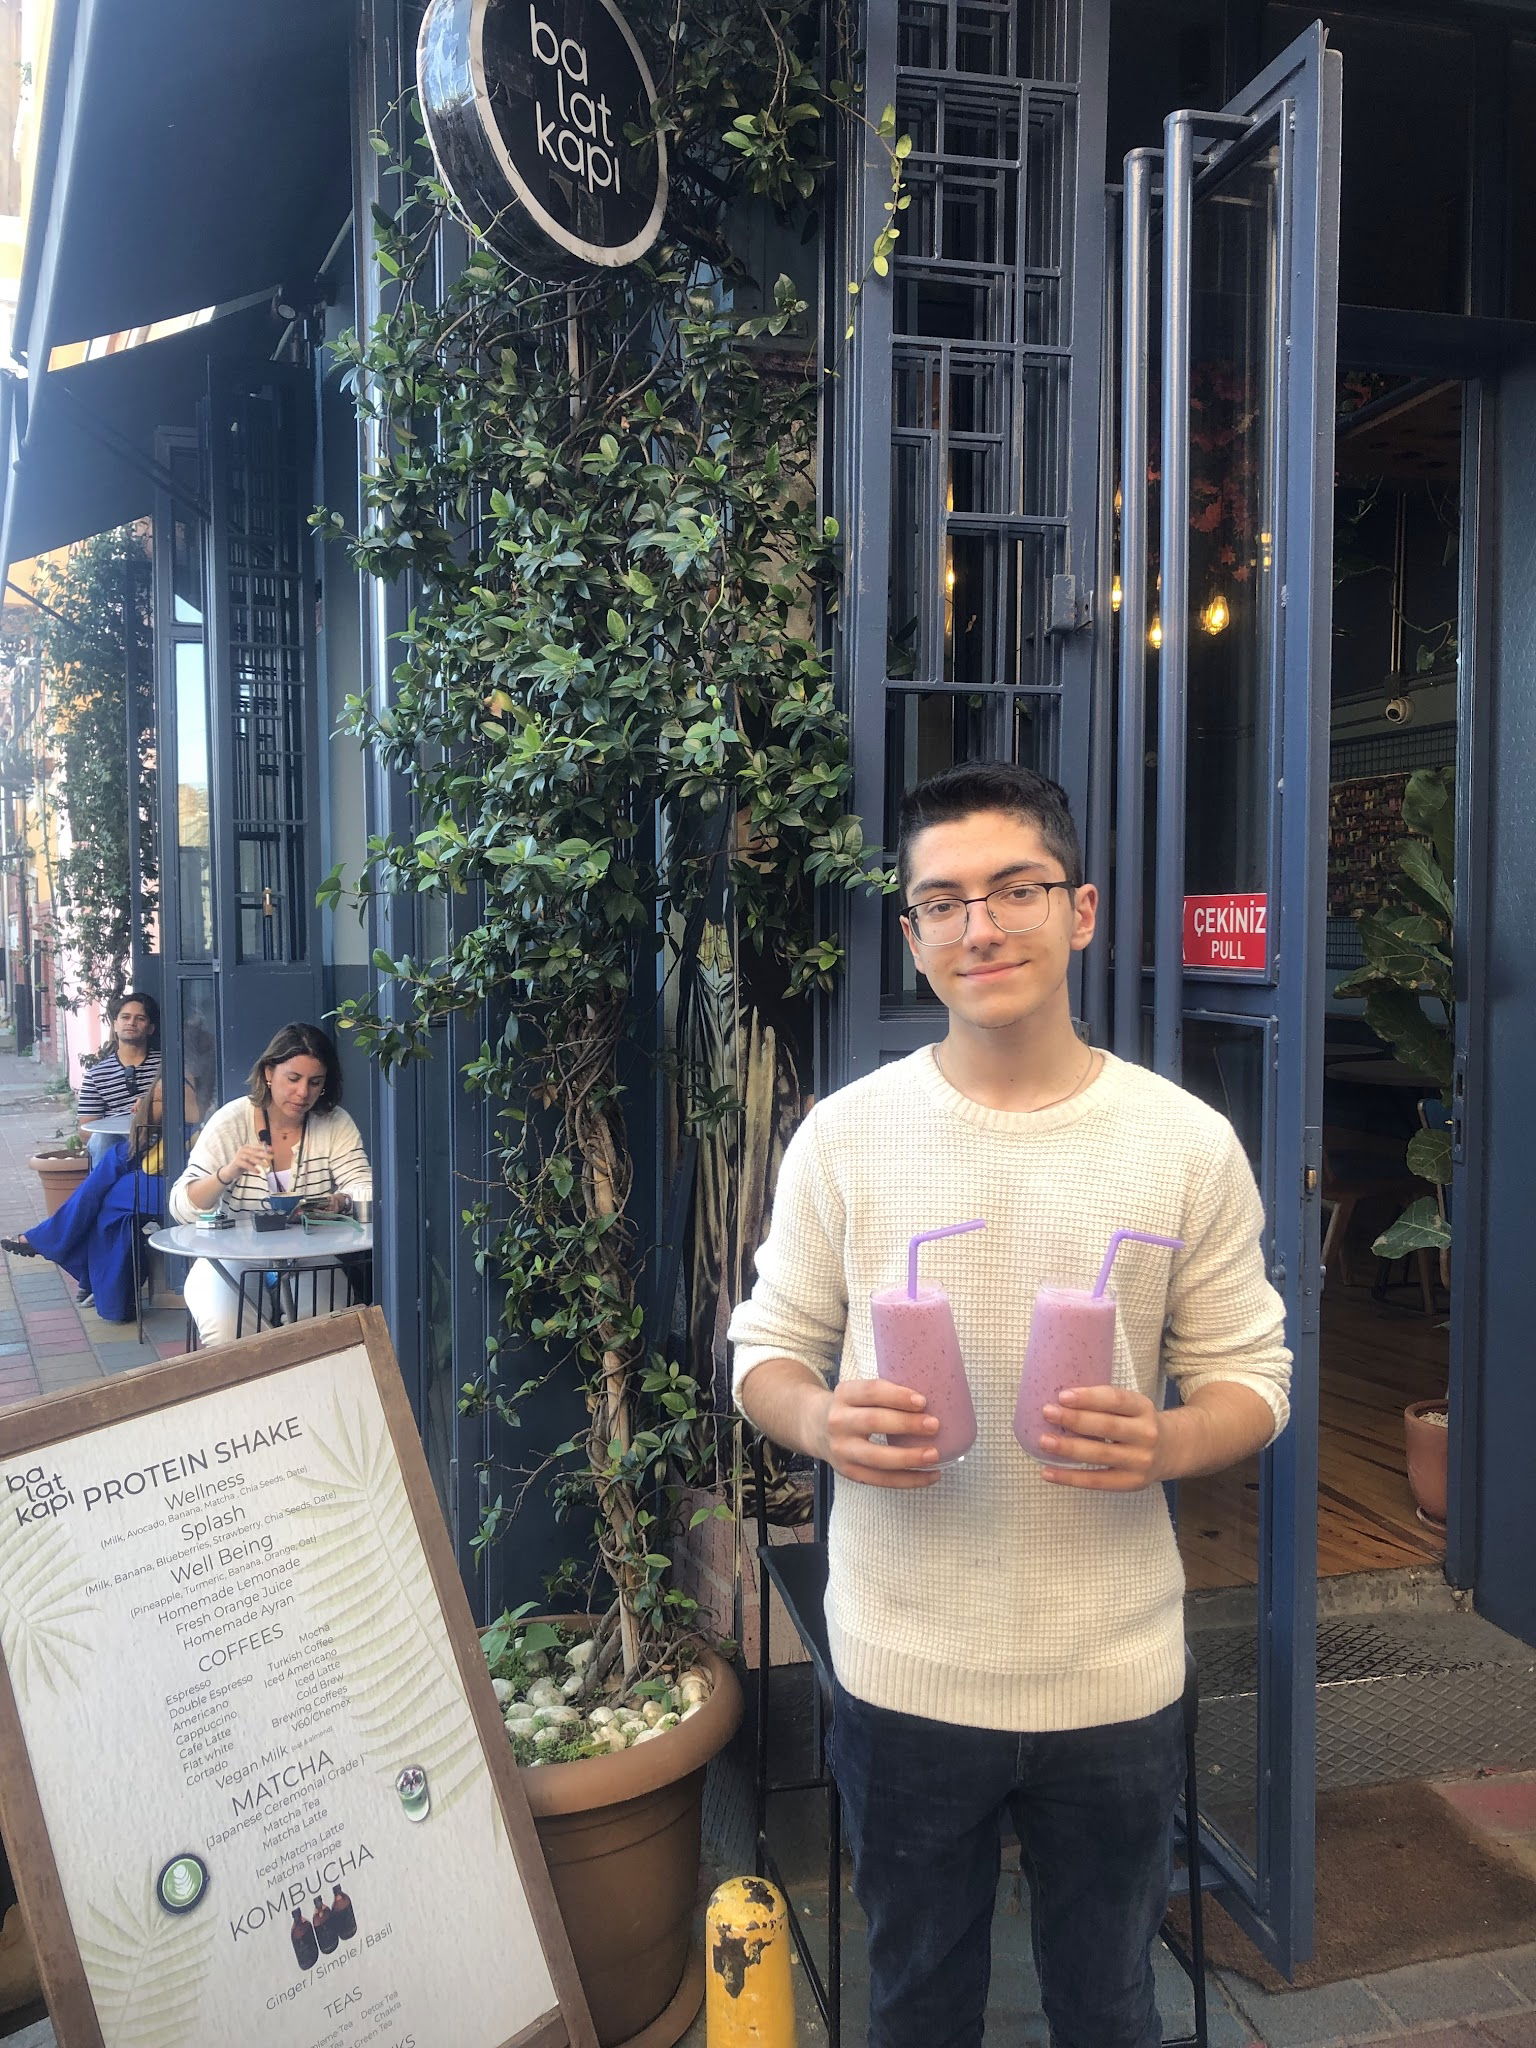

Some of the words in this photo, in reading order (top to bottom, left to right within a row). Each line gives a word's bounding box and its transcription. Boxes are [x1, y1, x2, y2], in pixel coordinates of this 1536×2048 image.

[530, 4, 588, 86] ba
[557, 69, 614, 147] lat
[536, 101, 621, 194] kapı
[1194, 900, 1266, 937] ÇEKİNİZ
[1211, 940, 1246, 960] PULL
[6, 1466, 45, 1493] ba
[83, 1449, 208, 1511] PROTEIN
[214, 1416, 303, 1463] SHAKE
[26, 1473, 66, 1502] lat
[101, 1534, 126, 1549] (Milk,
[127, 1519, 166, 1539] Avocado,
[168, 1505, 202, 1522] Banana,
[240, 1484, 258, 1496] Chia
[260, 1474, 286, 1489] Seeds,
[286, 1464, 308, 1479] Date)
[164, 1473, 245, 1510] Wellness
[85, 1580, 112, 1597] (Milk,
[114, 1564, 155, 1584] Banana,
[156, 1541, 212, 1567] Blueberries,
[212, 1520, 263, 1544] Strawberry,
[264, 1511, 284, 1524] Chia
[285, 1501, 312, 1516] Seeds,
[313, 1490, 337, 1504] Date)
[181, 1505, 245, 1541] Splash
[130, 1590, 183, 1619] (Pineapple,
[184, 1573, 228, 1595] Turmeric,
[228, 1558, 264, 1577] Banana,
[264, 1544, 298, 1562] Orange,
[298, 1535, 317, 1548] Oat)
[170, 1554, 214, 1584] Well
[218, 1534, 273, 1566] Being
[158, 1586, 234, 1624] Homemade
[237, 1558, 300, 1591] Lemonade
[175, 1613, 212, 1635] Fresh
[214, 1593, 260, 1618] Orange
[261, 1578, 293, 1598] Juice
[183, 1610, 258, 1650] Homemade
[261, 1595, 294, 1616] Ayran
[299, 1624, 330, 1644] Mocha
[199, 1623, 284, 1672] COFFEES
[263, 1672, 285, 1688] Iced
[287, 1648, 337, 1678] Americano
[268, 1650, 302, 1671] Turkish
[304, 1636, 334, 1655] Coffee
[165, 1679, 211, 1705] Espresso
[294, 1671, 315, 1687] Iced
[316, 1661, 340, 1677] Latte
[296, 1685, 318, 1701] Cold
[320, 1672, 344, 1689] Brew
[169, 1695, 207, 1719] Double
[208, 1674, 253, 1700] Espresso
[173, 1700, 229, 1733] Americano
[272, 1702, 312, 1728] Brewing
[313, 1685, 348, 1707] Coffees
[176, 1711, 237, 1745] Cappuccino
[179, 1743, 203, 1759] Cafe
[205, 1728, 231, 1746] Latte
[183, 1757, 203, 1773] Flat
[205, 1742, 234, 1761] white
[186, 1760, 228, 1786] Cortado
[215, 1761, 258, 1789] Vegan
[261, 1745, 288, 1766] Milk
[232, 1749, 334, 1816] MATCHA
[206, 1811, 262, 1850] (Japanese
[264, 1774, 326, 1815] Ceremonial
[327, 1759, 359, 1781] Grade
[263, 1807, 301, 1834] Matcha
[302, 1797, 321, 1812] Tea
[262, 1823, 300, 1850] Matcha
[302, 1808, 328, 1828] Latte
[255, 1861, 278, 1879] Iced
[280, 1838, 318, 1865] Matcha
[319, 1821, 345, 1841] Latte
[267, 1861, 305, 1888] Matcha
[306, 1839, 342, 1865] Frappe
[230, 1844, 375, 1942] KOMBUCHA
[266, 1978, 308, 2010] Ginger
[316, 1947, 357, 1979] Simple
[365, 1922, 393, 1948] Basil
[323, 1986, 363, 2019] TEAS
[384, 1991, 398, 2003] Tea
[338, 2021, 354, 2032] Tea
[379, 2020, 392, 2032] Tea
